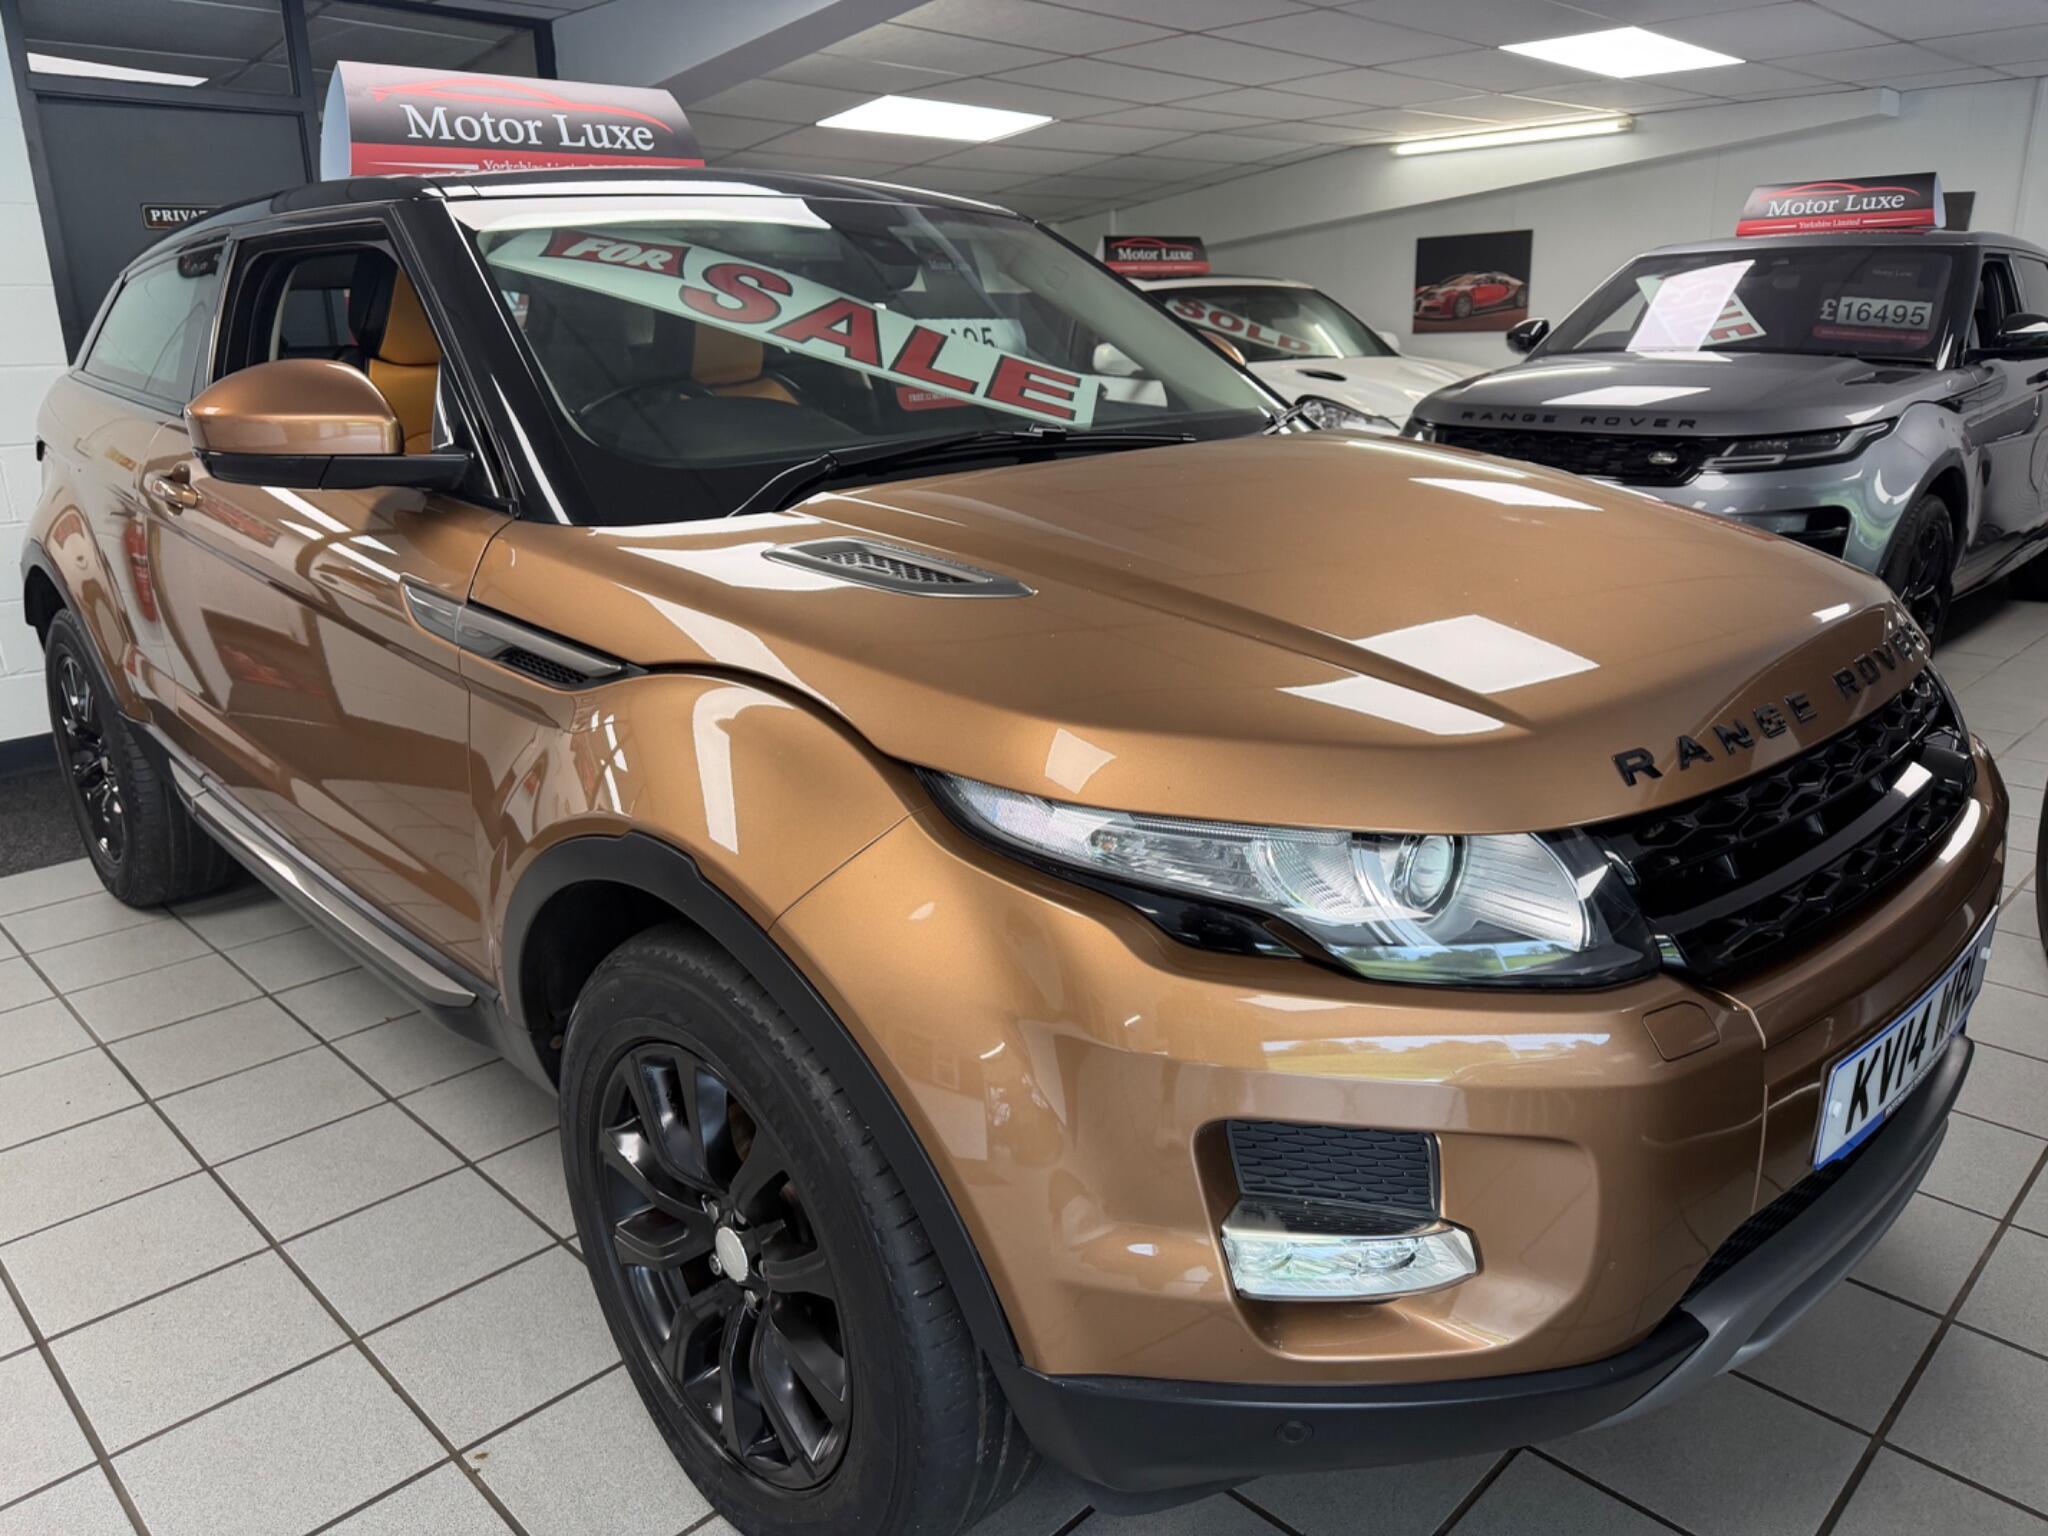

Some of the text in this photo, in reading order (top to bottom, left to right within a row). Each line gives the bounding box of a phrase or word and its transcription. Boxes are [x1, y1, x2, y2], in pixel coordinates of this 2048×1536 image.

[400, 104, 655, 151] Motor Luxe
[1765, 194, 1905, 217] Motor Luxe
[1118, 248, 1194, 261] Motor Luxe
[562, 237, 1082, 421] FOR SALE
[1173, 298, 1312, 352] SOLD
[1461, 411, 1697, 429] RANGE ROVER
[1611, 691, 1817, 786] RANGE
[1845, 1001, 1933, 1135] KV14
